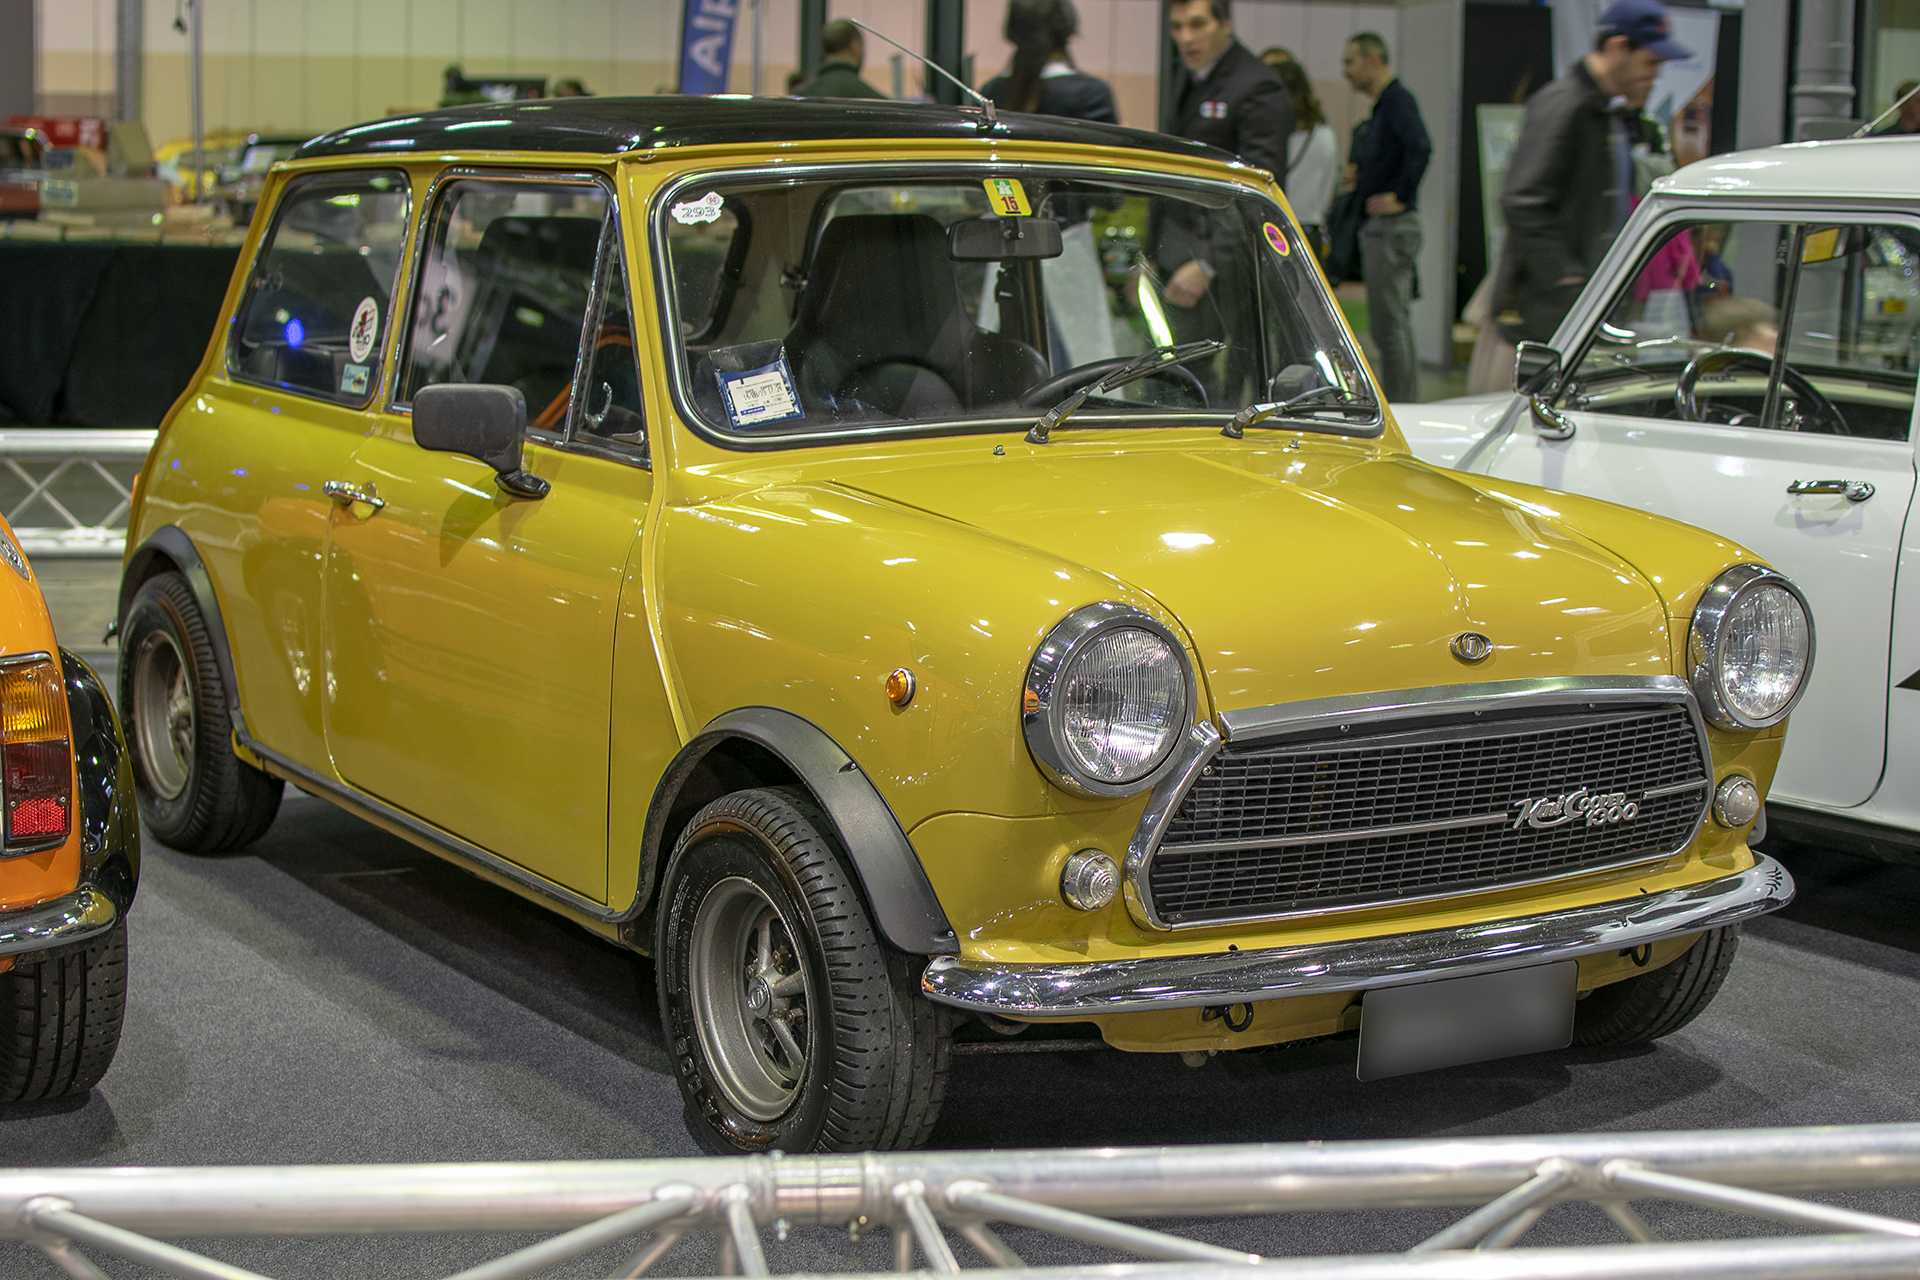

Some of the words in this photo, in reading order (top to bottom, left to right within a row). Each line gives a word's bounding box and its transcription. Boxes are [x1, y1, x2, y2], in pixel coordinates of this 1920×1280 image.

[681, 206, 716, 218] 293
[1001, 196, 1019, 211] 15
[1512, 794, 1566, 828] Mini
[1584, 802, 1639, 827] 1300
